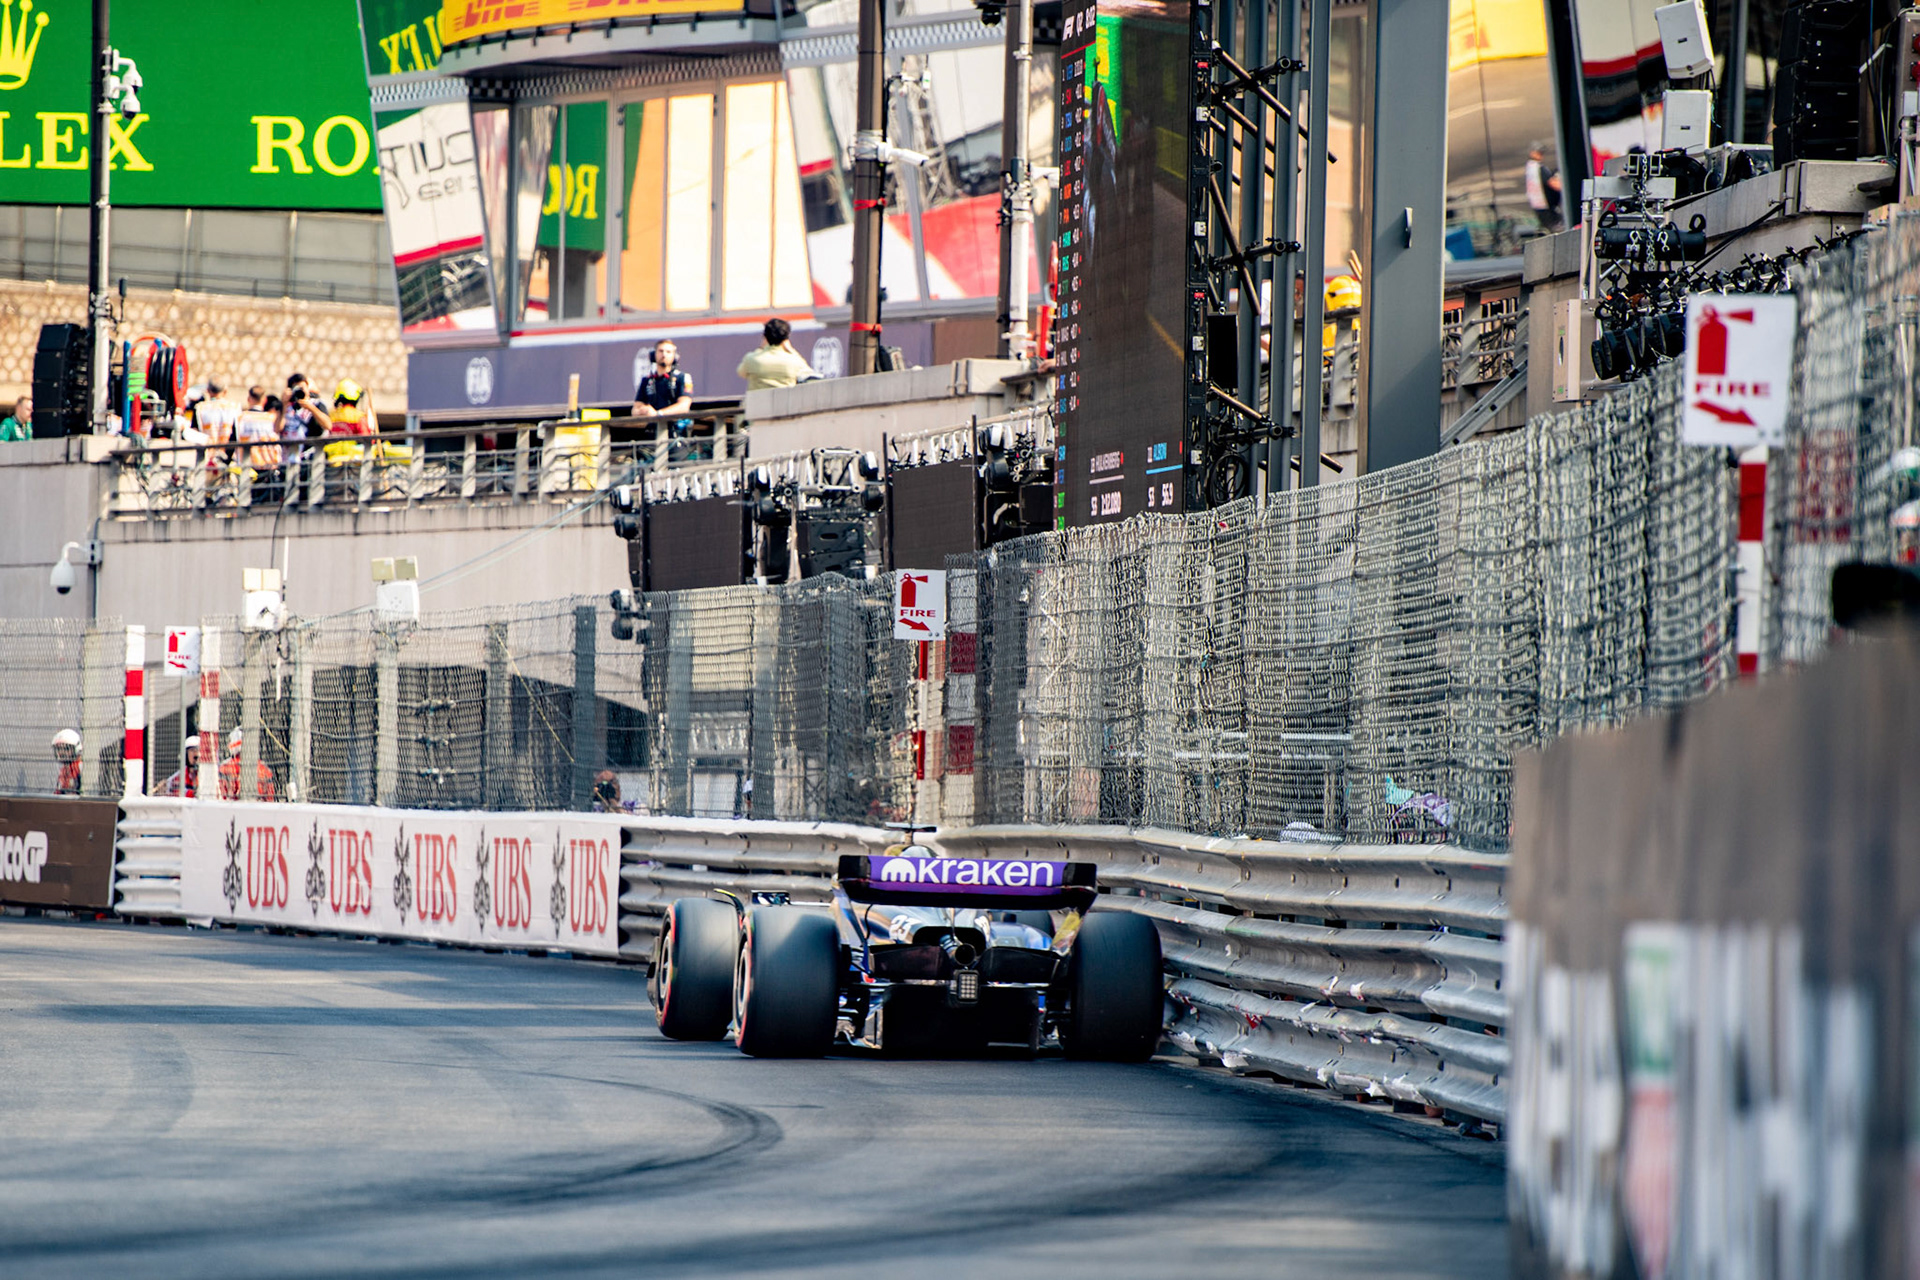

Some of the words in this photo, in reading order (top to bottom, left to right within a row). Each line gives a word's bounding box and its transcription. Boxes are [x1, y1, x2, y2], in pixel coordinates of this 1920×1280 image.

[251, 115, 380, 177] RO
[1695, 379, 1771, 397] FIRE
[900, 609, 936, 617] FIRE
[246, 826, 290, 908] UBS
[329, 830, 373, 915] UBS
[414, 833, 457, 922] UBS
[494, 837, 531, 929] UBS
[570, 839, 609, 934] UBS
[918, 858, 1054, 887] kraken
